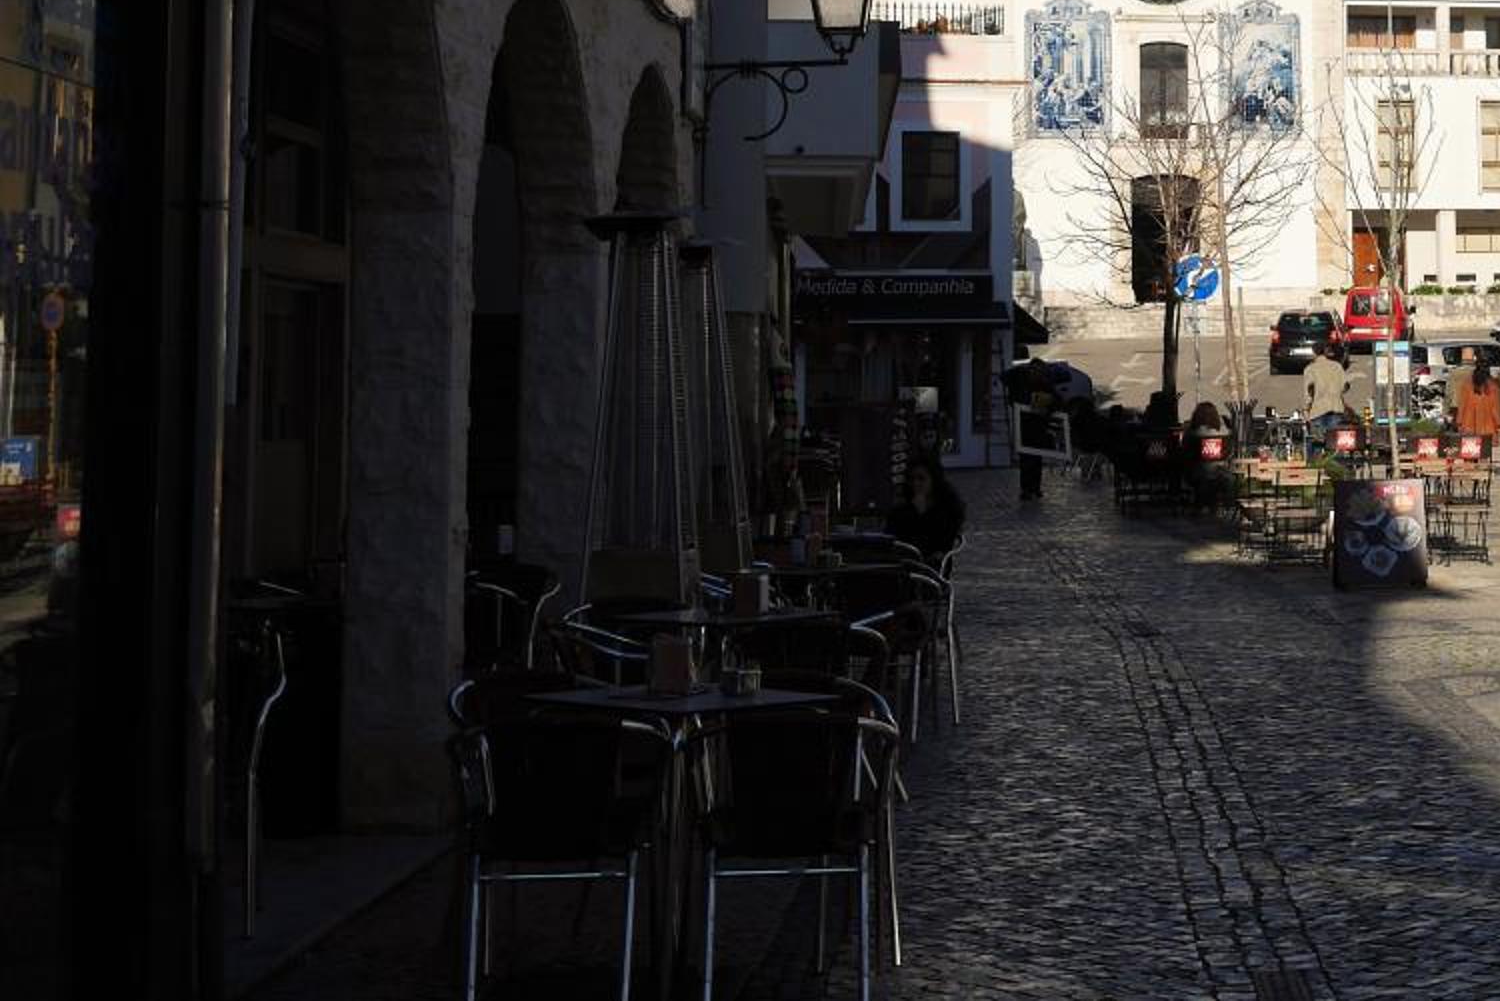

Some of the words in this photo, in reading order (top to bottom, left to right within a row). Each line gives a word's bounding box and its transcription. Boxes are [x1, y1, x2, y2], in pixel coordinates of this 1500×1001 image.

[797, 277, 857, 295] Medida
[862, 278, 875, 294] &
[881, 277, 976, 298] Companhia
